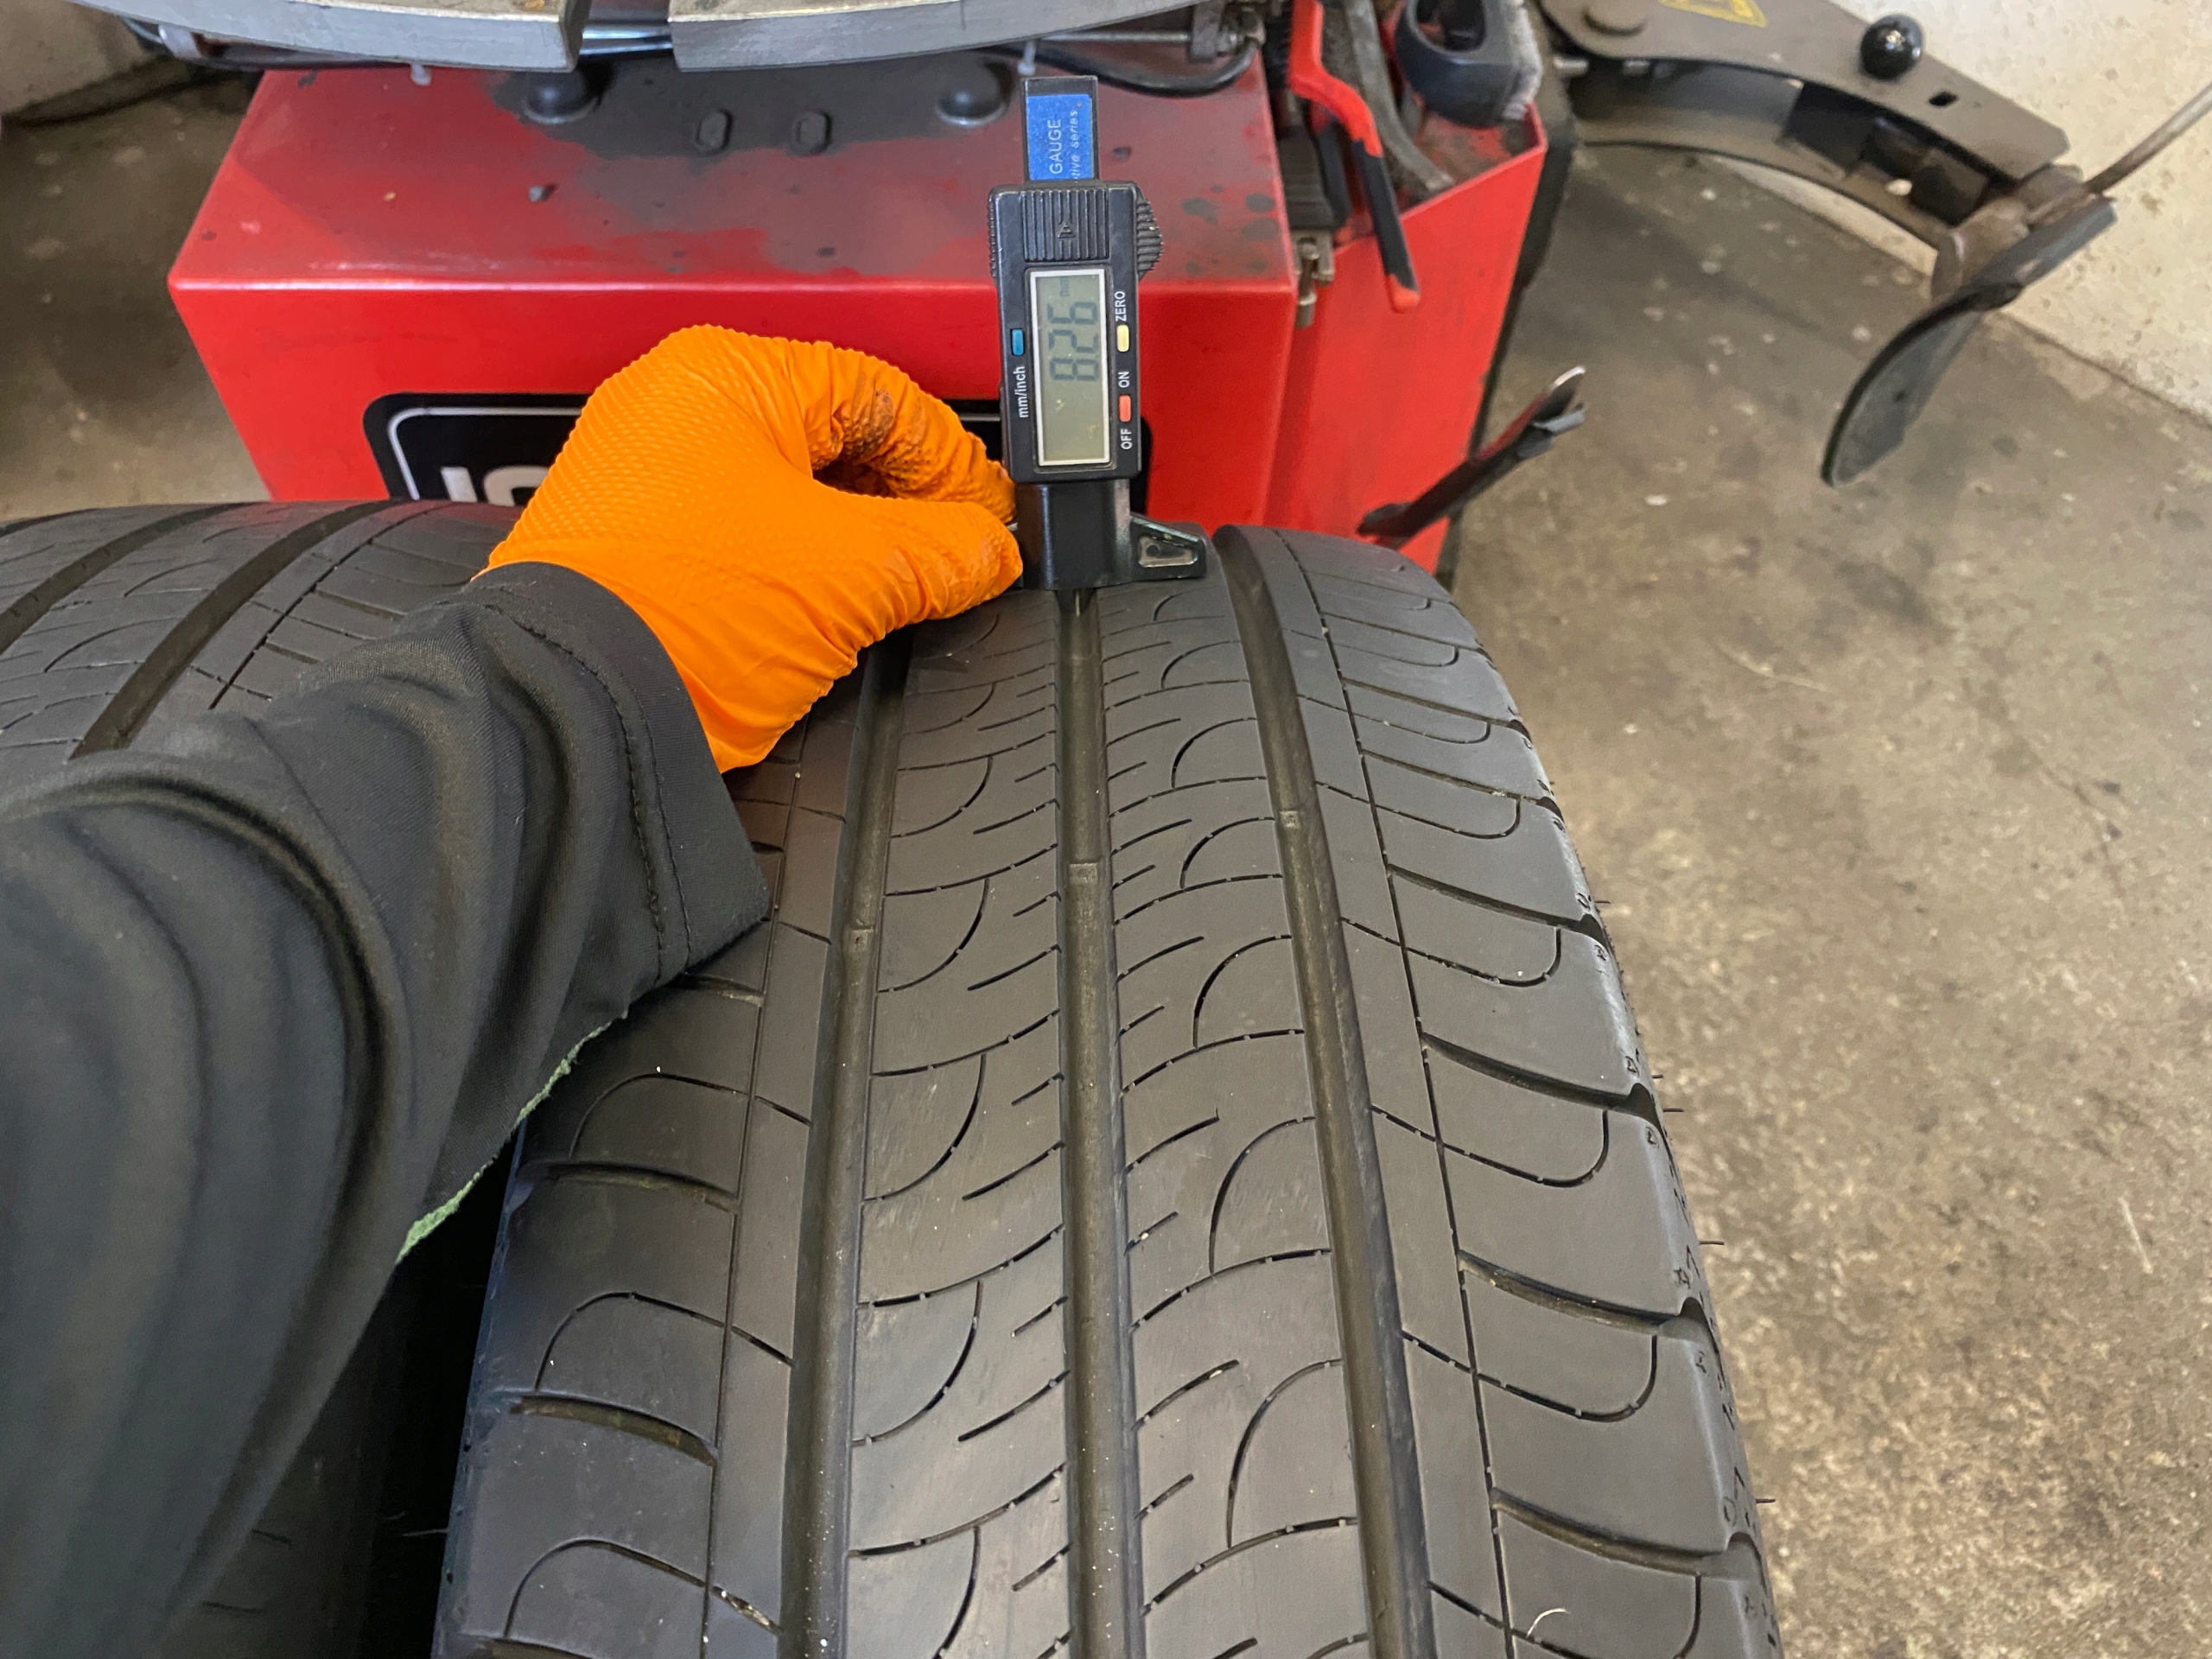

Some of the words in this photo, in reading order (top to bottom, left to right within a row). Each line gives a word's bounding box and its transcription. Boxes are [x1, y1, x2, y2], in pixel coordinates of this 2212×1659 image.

[1047, 119, 1063, 174] GAUGE
[1114, 290, 1127, 321] ZERO
[1013, 365, 1028, 418] mm/inch
[1118, 371, 1130, 388] ON
[1120, 428, 1133, 450] OFF
